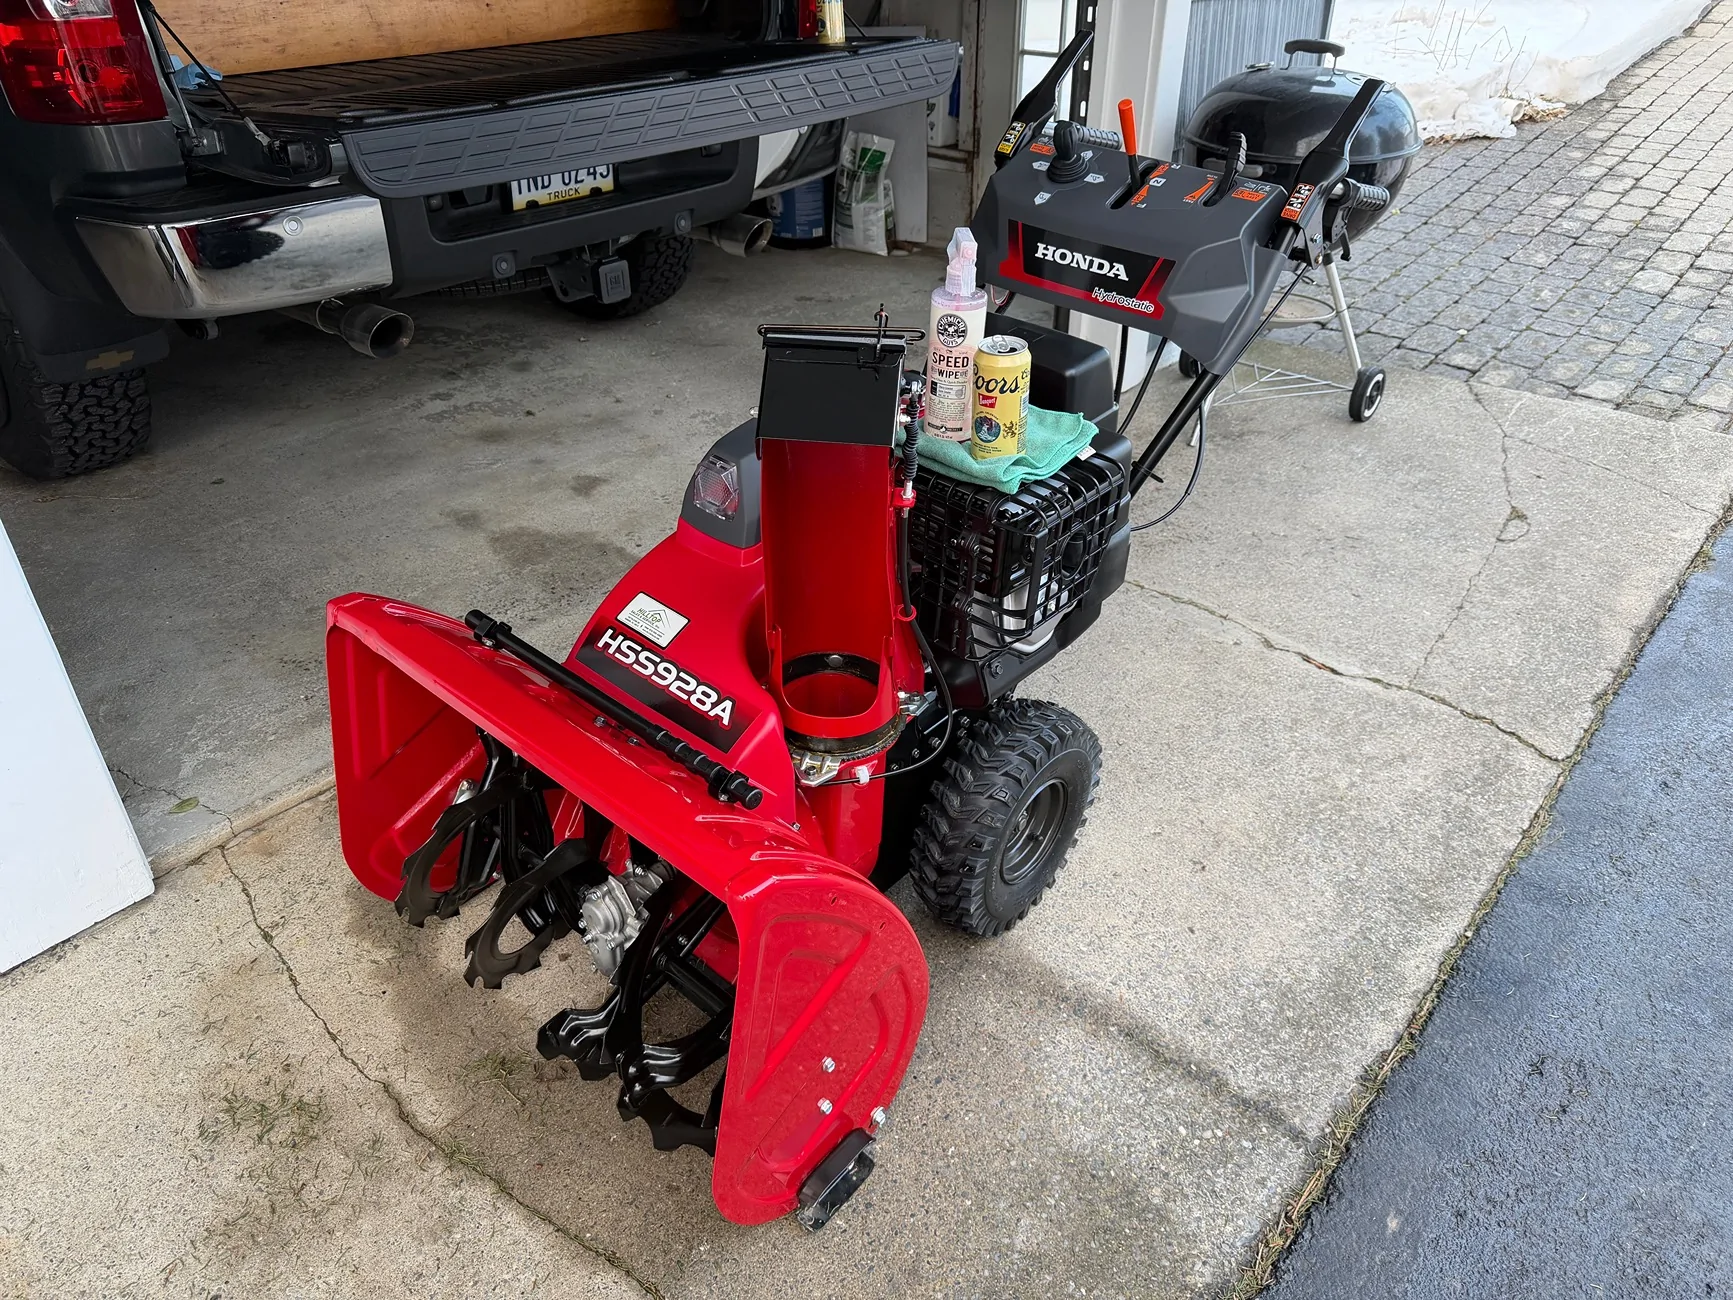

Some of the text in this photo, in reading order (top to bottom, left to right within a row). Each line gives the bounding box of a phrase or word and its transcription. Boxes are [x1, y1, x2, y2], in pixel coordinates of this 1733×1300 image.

[547, 187, 581, 201] TRUCK
[1034, 242, 1129, 281] HONDA
[1091, 286, 1155, 314] Hydrostatic
[937, 314, 966, 334] CHEMICAL
[942, 337, 959, 347] GUYS
[932, 351, 970, 368] SPEED
[937, 368, 960, 379] WIPE
[637, 607, 662, 624] HILLTOP
[597, 628, 733, 727] HSS928A
